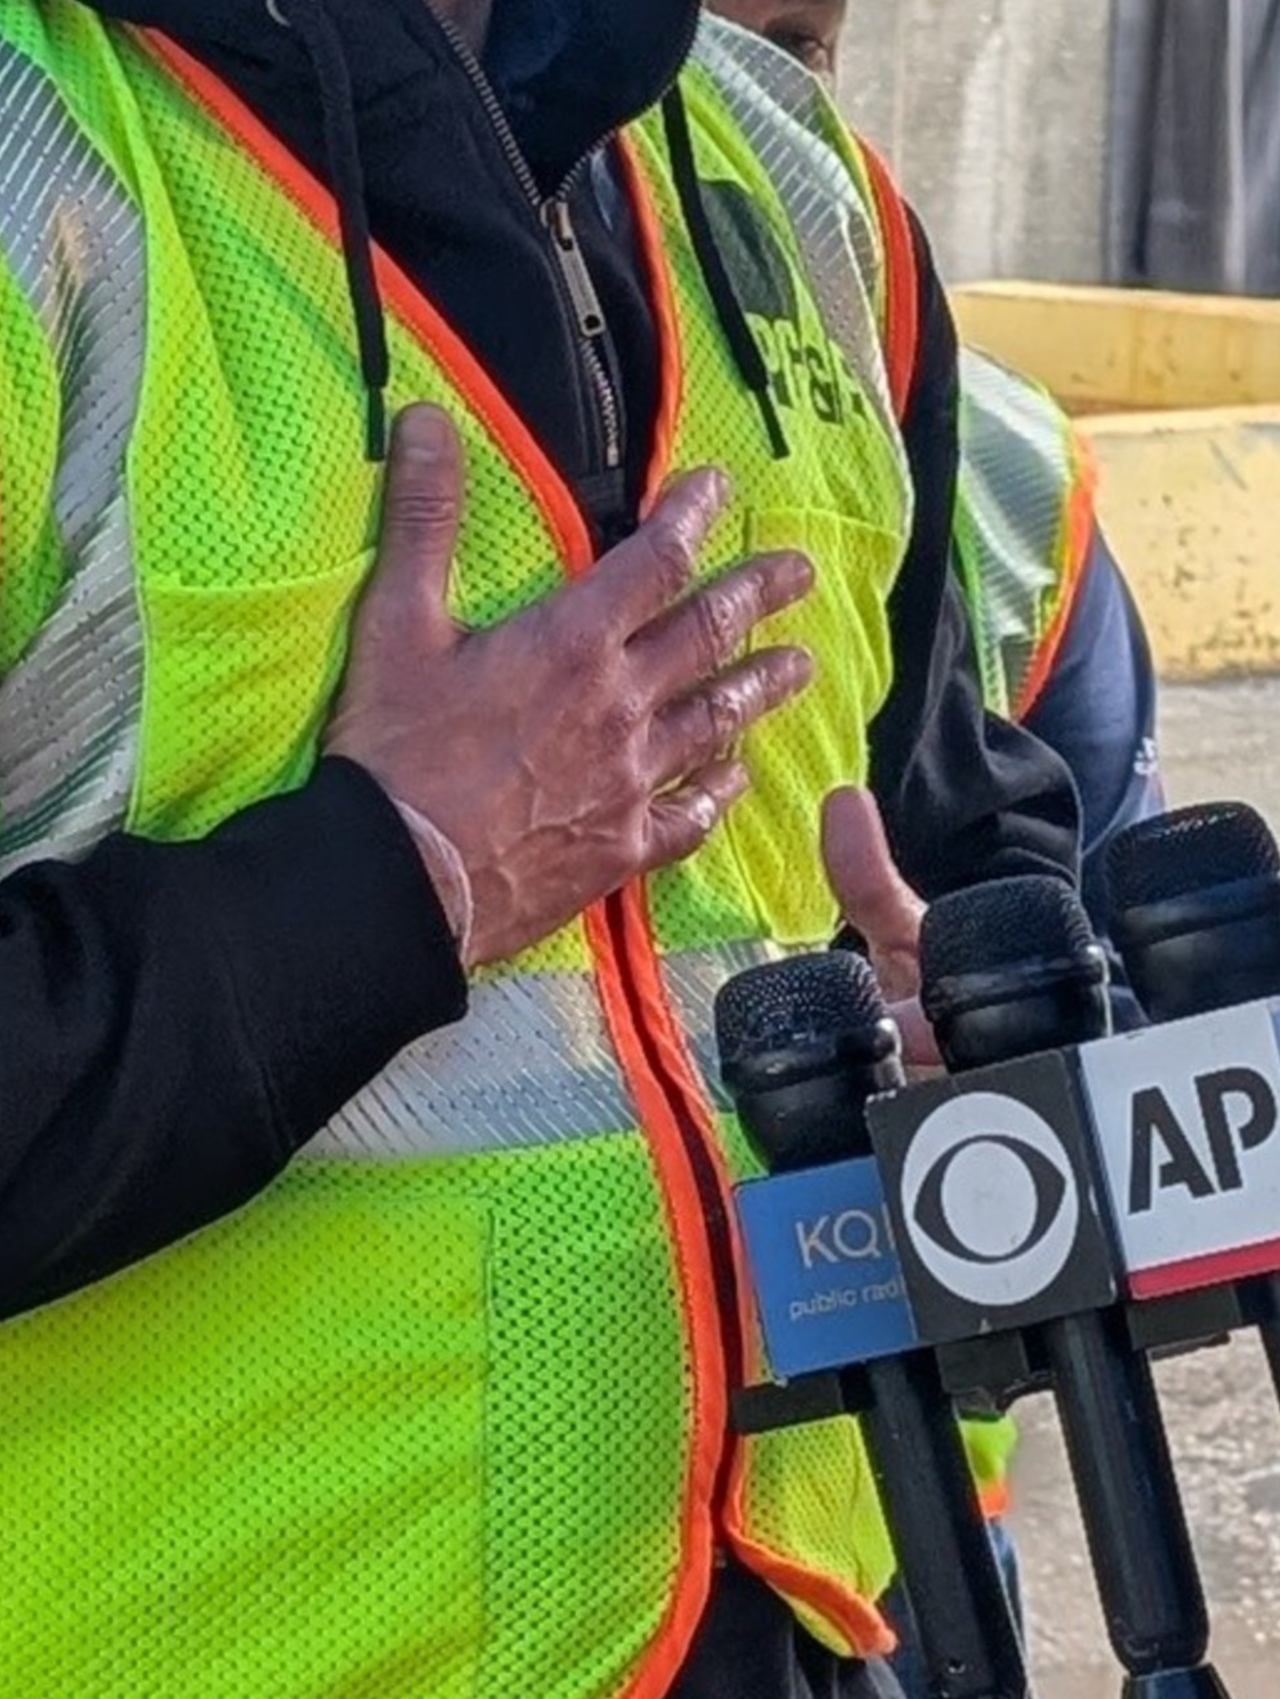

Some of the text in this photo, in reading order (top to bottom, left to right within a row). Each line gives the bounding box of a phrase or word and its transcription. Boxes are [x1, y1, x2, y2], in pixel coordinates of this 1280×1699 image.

[1128, 1066, 1279, 1215] AP
[795, 1201, 896, 1269] KQ
[789, 1286, 858, 1321] public
